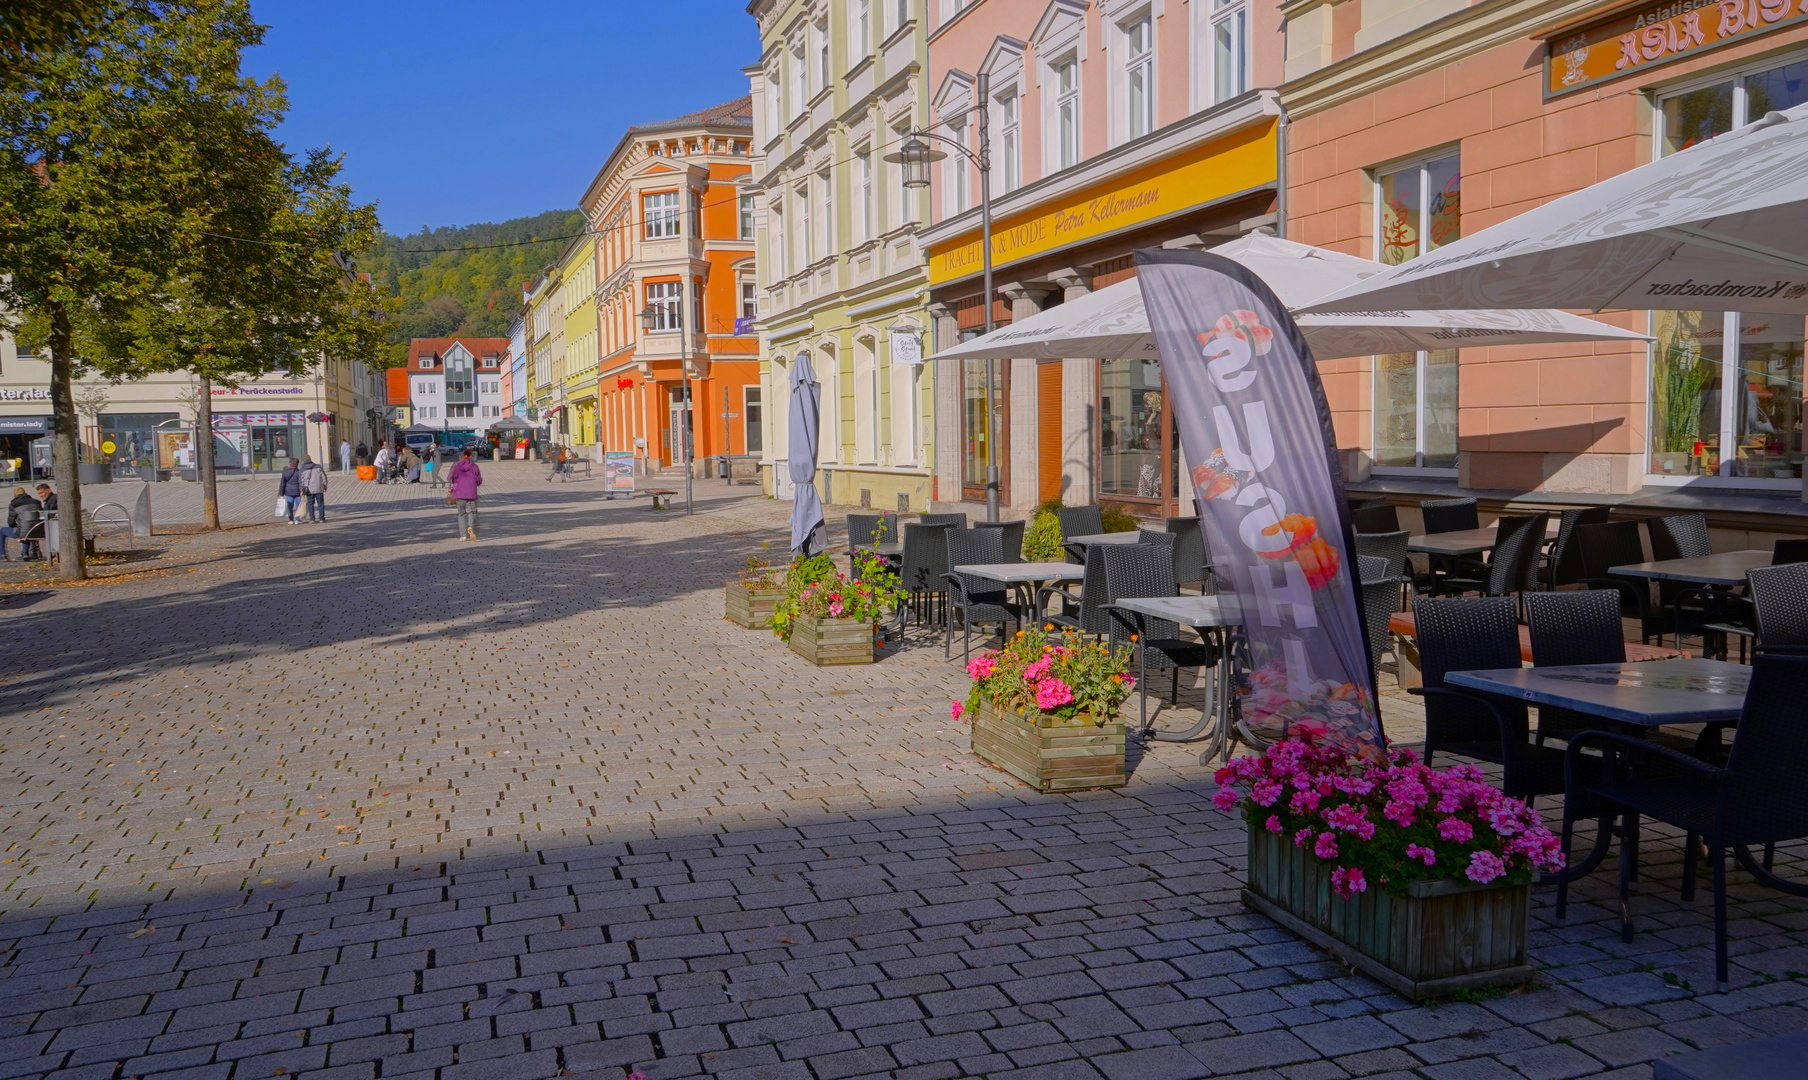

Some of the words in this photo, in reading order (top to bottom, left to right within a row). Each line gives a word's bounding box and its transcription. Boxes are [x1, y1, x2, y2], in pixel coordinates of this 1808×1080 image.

[1634, 0, 1724, 30] Asiatisc
[1615, 11, 1705, 70] ASIA
[943, 236, 997, 271] TRACHTN
[998, 236, 1010, 255] &
[1010, 217, 1046, 251] MODE
[1054, 210, 1085, 237] Petra
[1088, 187, 1160, 224] Kellermann
[240, 387, 303, 395] Perückenstudio
